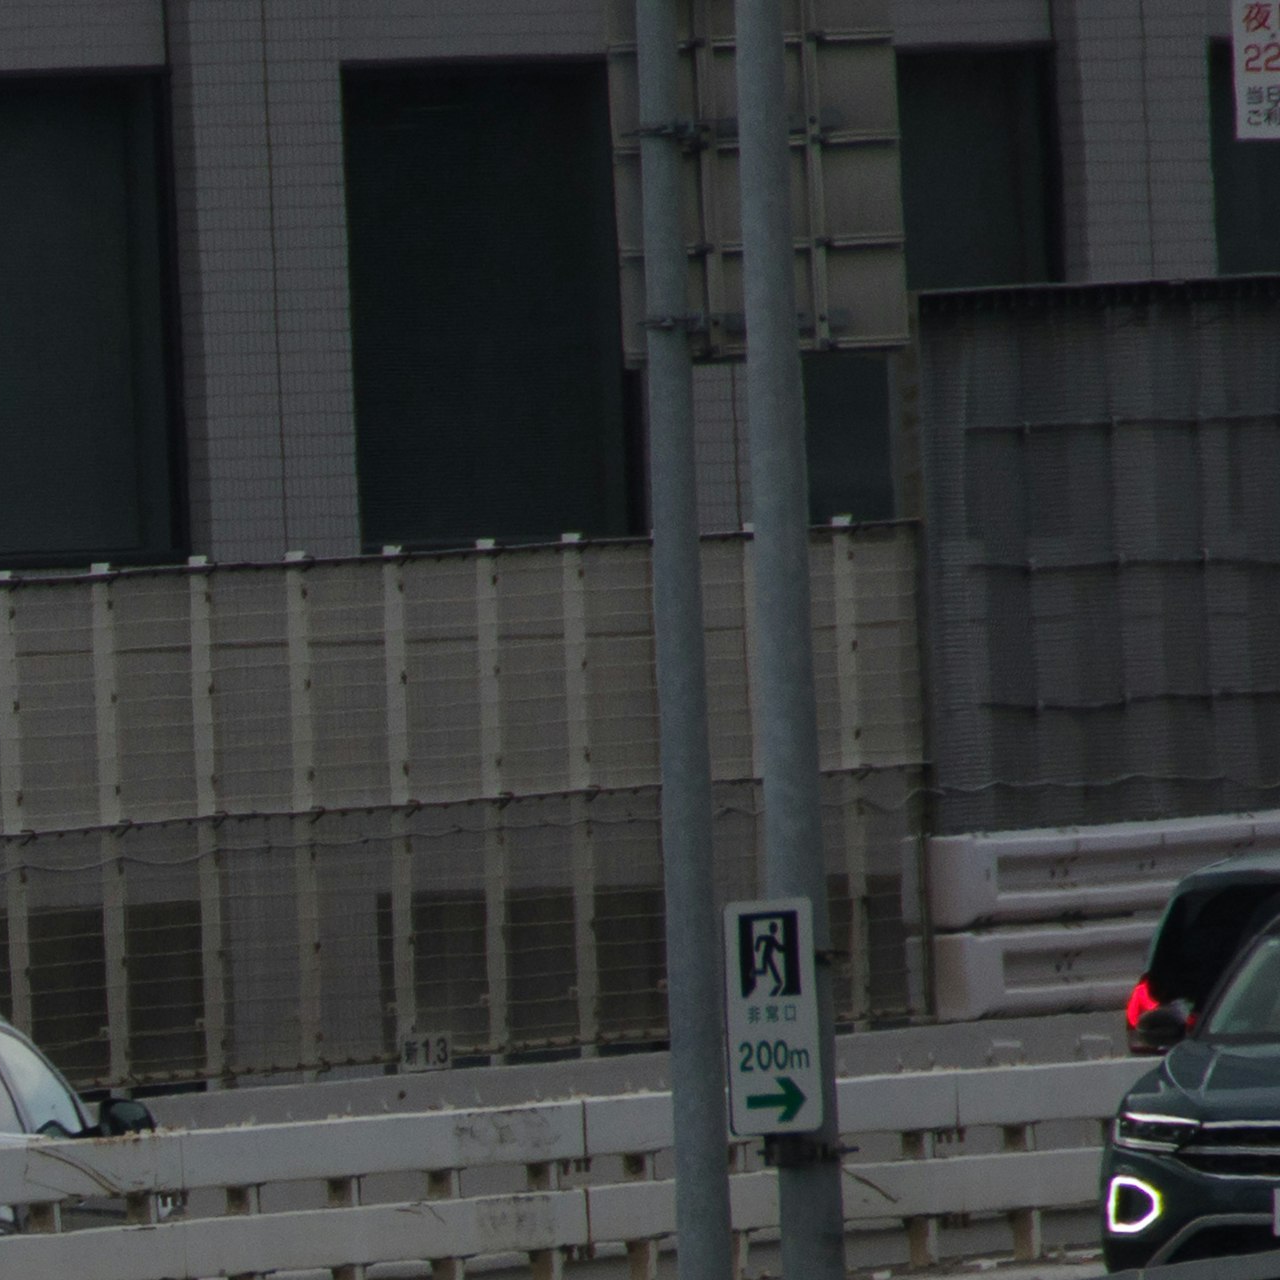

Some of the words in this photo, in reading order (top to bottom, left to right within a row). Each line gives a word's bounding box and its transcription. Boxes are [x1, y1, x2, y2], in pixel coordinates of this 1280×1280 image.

[748, 1004, 797, 1024] 非常口
[740, 1039, 809, 1072] 200m
